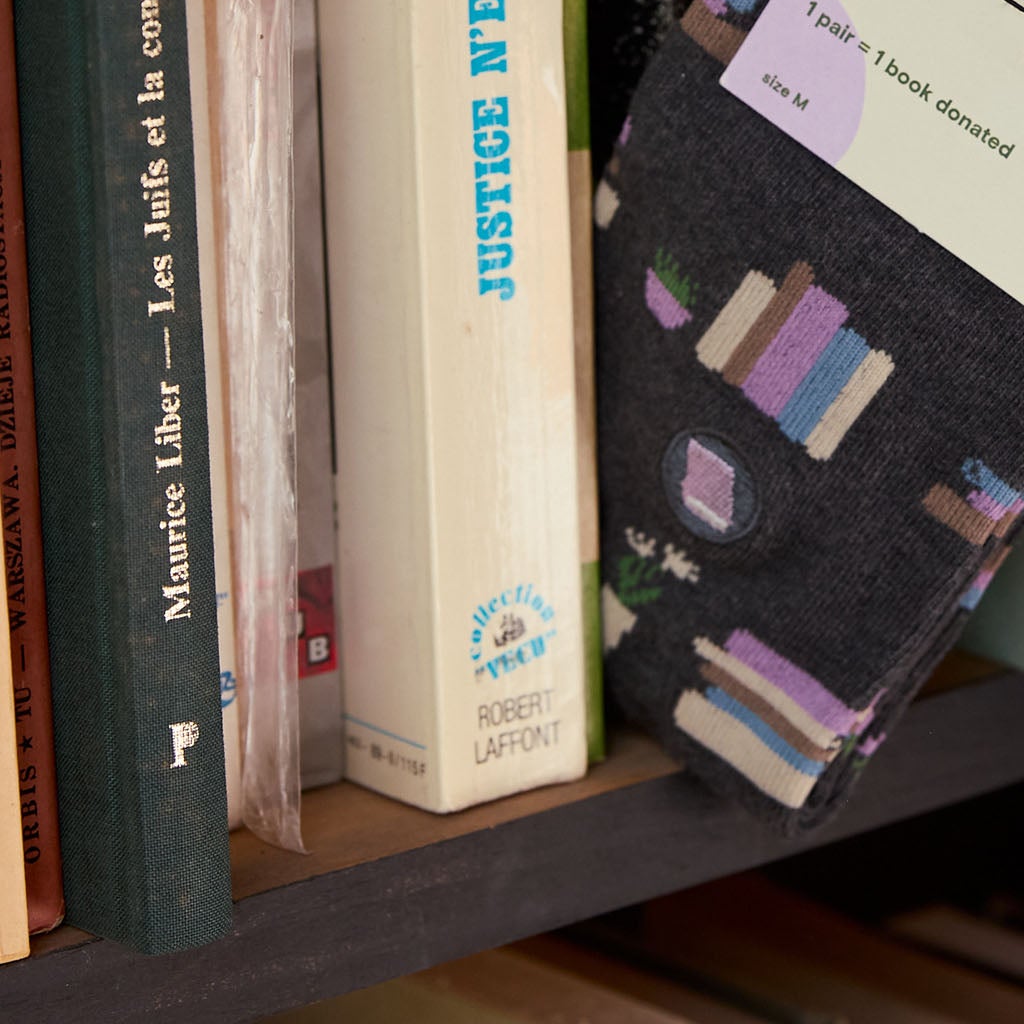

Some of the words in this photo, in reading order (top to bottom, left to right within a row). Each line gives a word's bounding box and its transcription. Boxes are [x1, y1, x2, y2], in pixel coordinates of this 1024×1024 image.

[136, 69, 165, 106] la
[761, 71, 790, 98] size
[792, 92, 810, 112] M
[814, 12, 856, 44] pair
[884, 58, 933, 102] book
[935, 99, 1016, 159] donated
[140, 114, 167, 148] et
[140, 157, 172, 242] Juifs
[471, 95, 515, 301] JUSTICE
[147, 253, 177, 318] Les
[0, 355, 17, 452] DZIEJE
[154, 380, 183, 473] Liber
[158, 481, 192, 624] Maurice
[469, 582, 555, 662] collection
[14, 685, 33, 724] TU
[474, 719, 562, 766] LAFFONT
[477, 689, 556, 730] ROBERT
[19, 764, 41, 865] ORBIS
